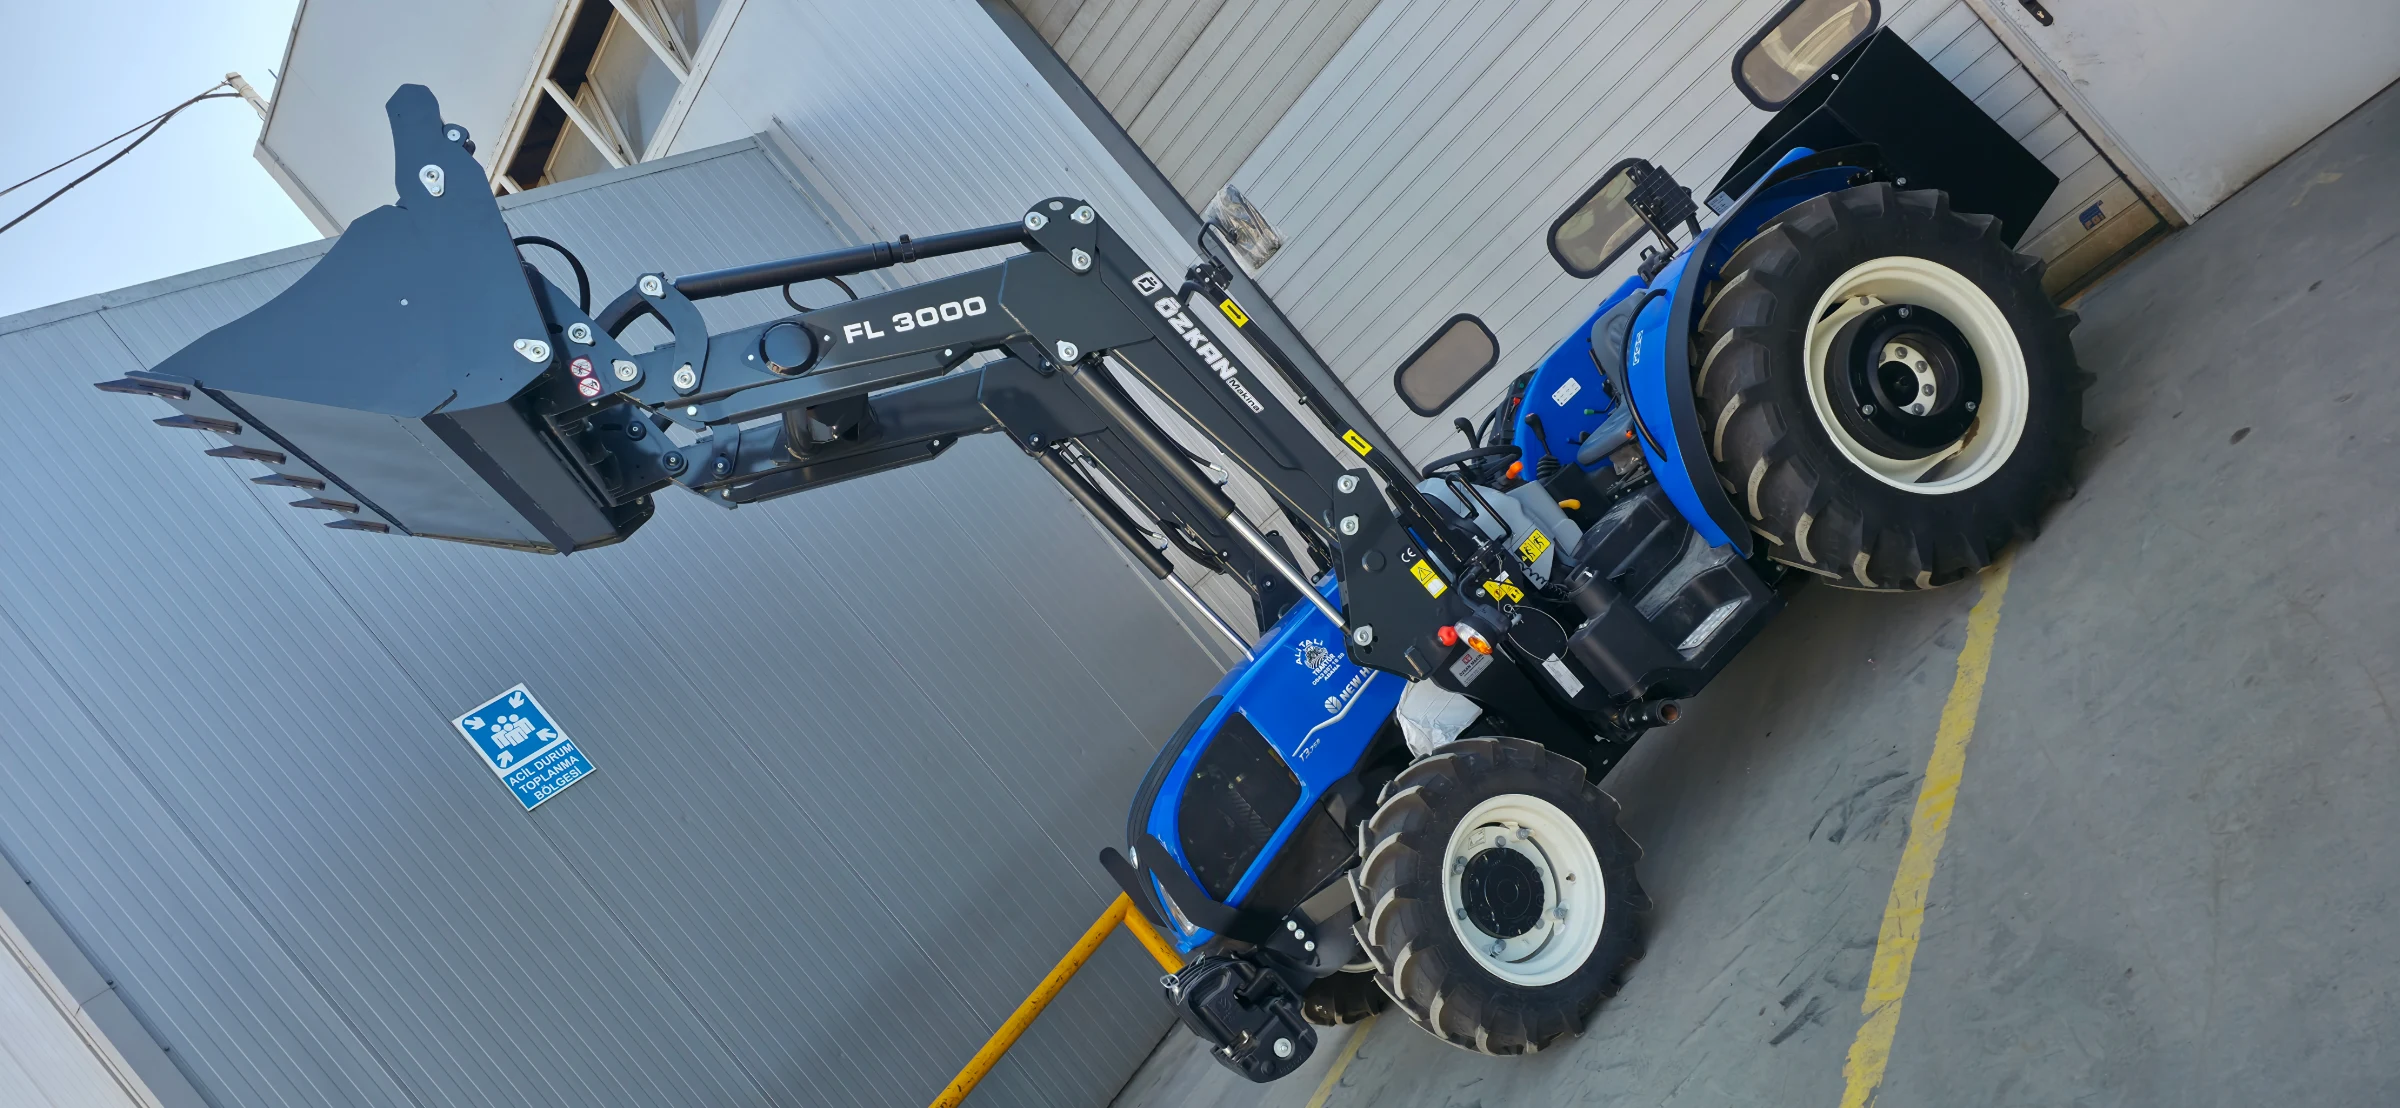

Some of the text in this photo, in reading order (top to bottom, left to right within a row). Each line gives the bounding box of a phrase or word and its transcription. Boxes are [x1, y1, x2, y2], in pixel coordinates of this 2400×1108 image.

[843, 296, 987, 344] FL 3000
[1154, 296, 1238, 381] ÖZKAN
[1229, 378, 1261, 412] Makina
[1339, 674, 1362, 702] NEW
[509, 742, 575, 787] ACİL DURUM
[518, 755, 580, 794] TOPLANMA
[533, 766, 582, 801] BÖLGESİ
